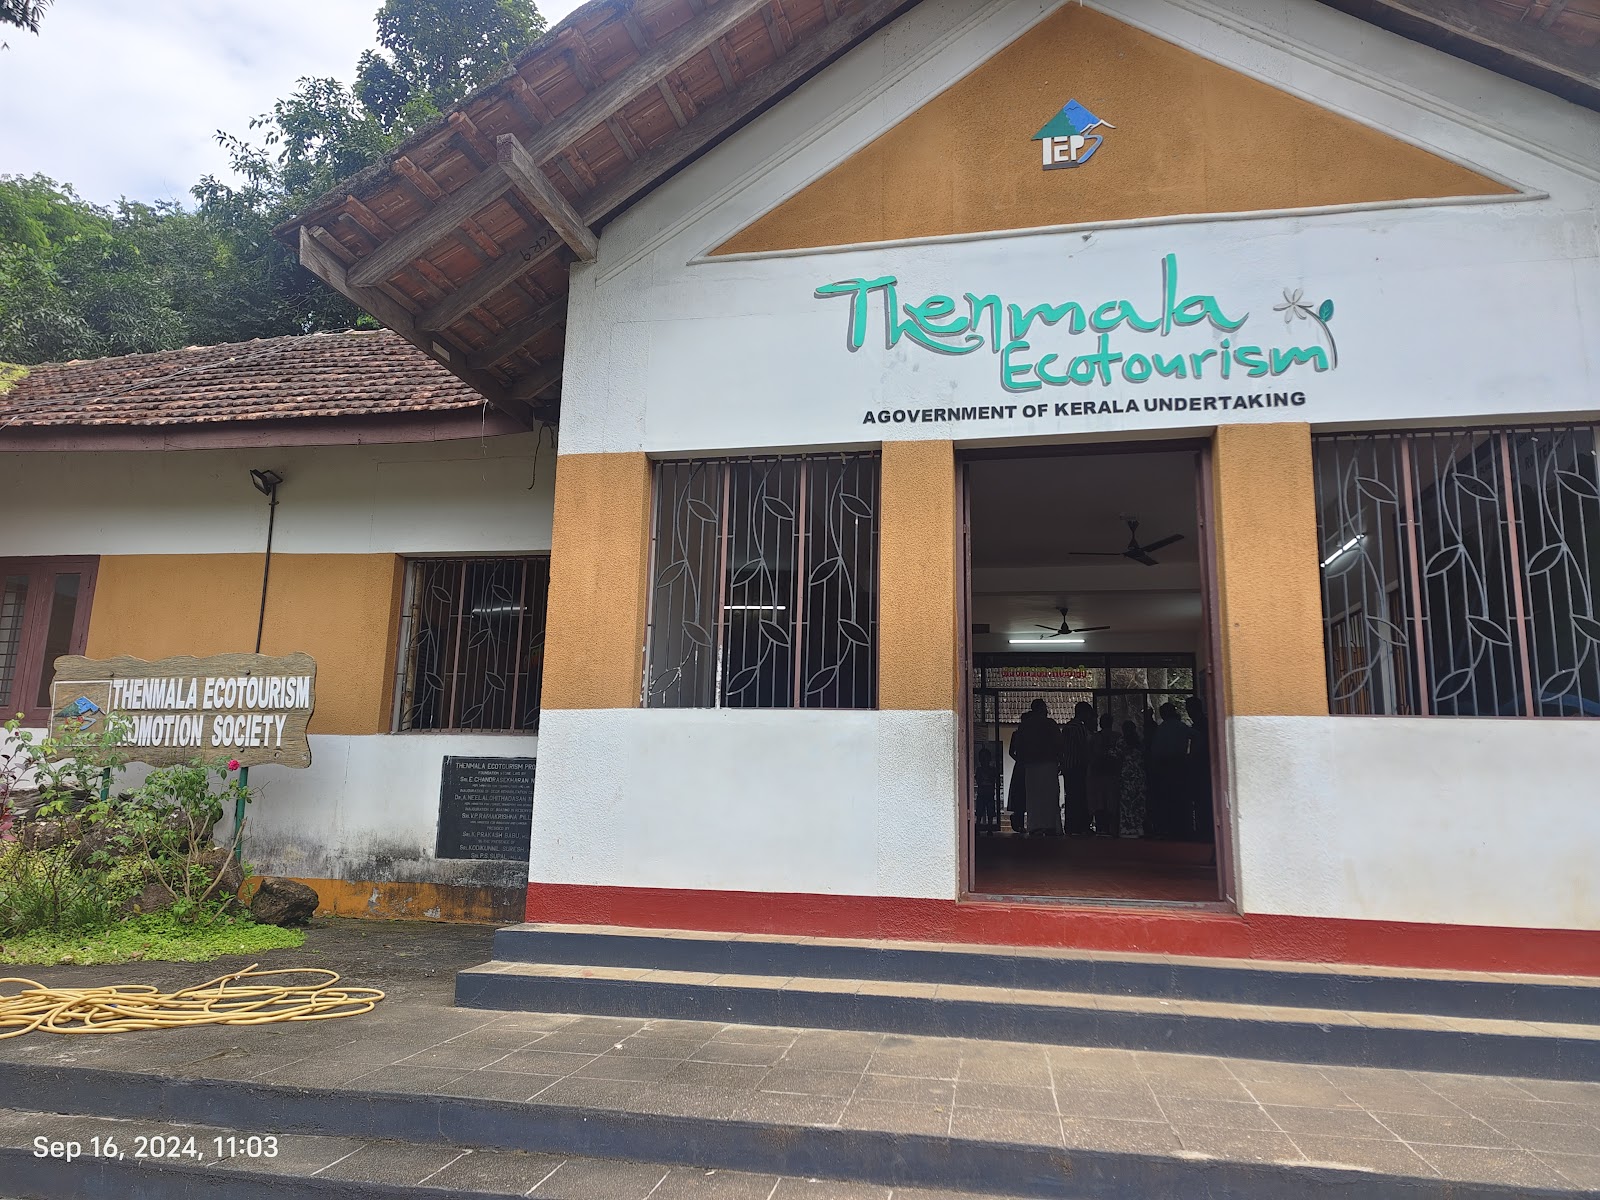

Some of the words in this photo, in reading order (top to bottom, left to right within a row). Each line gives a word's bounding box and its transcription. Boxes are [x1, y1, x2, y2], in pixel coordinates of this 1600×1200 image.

[814, 253, 1249, 355] Thenmala
[1000, 333, 1329, 392] Ecotourism
[1022, 404, 1048, 418] OF
[1054, 399, 1139, 417] KERALA
[1144, 391, 1306, 412] UNDERTAKING
[113, 677, 197, 709] THENMALA
[202, 676, 310, 709] ECOTOURISM
[211, 714, 288, 747] SOCIETY
